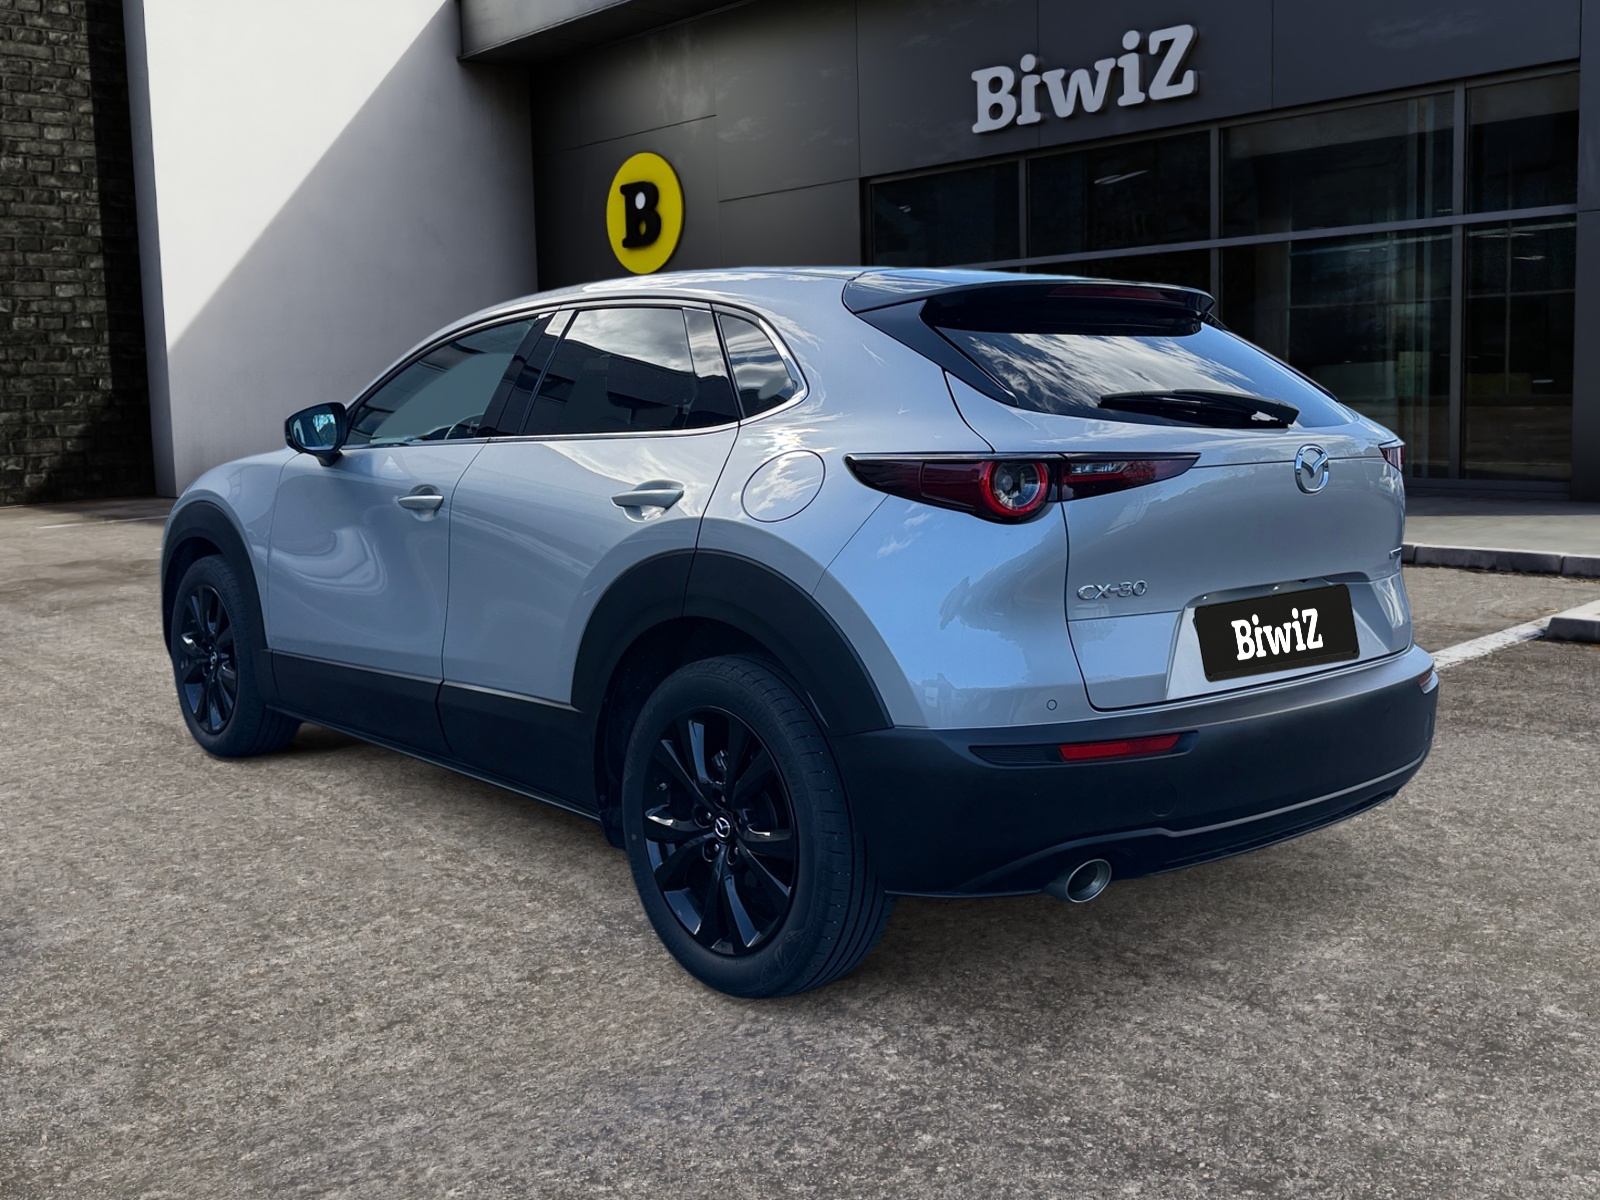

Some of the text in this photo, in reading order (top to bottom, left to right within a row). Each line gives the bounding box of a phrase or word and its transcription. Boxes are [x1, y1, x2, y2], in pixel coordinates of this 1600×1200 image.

[971, 24, 1197, 133] BiwiZ
[620, 181, 662, 249] B
[1077, 579, 1148, 600] CX-30
[1231, 607, 1324, 661] BiwiZ
